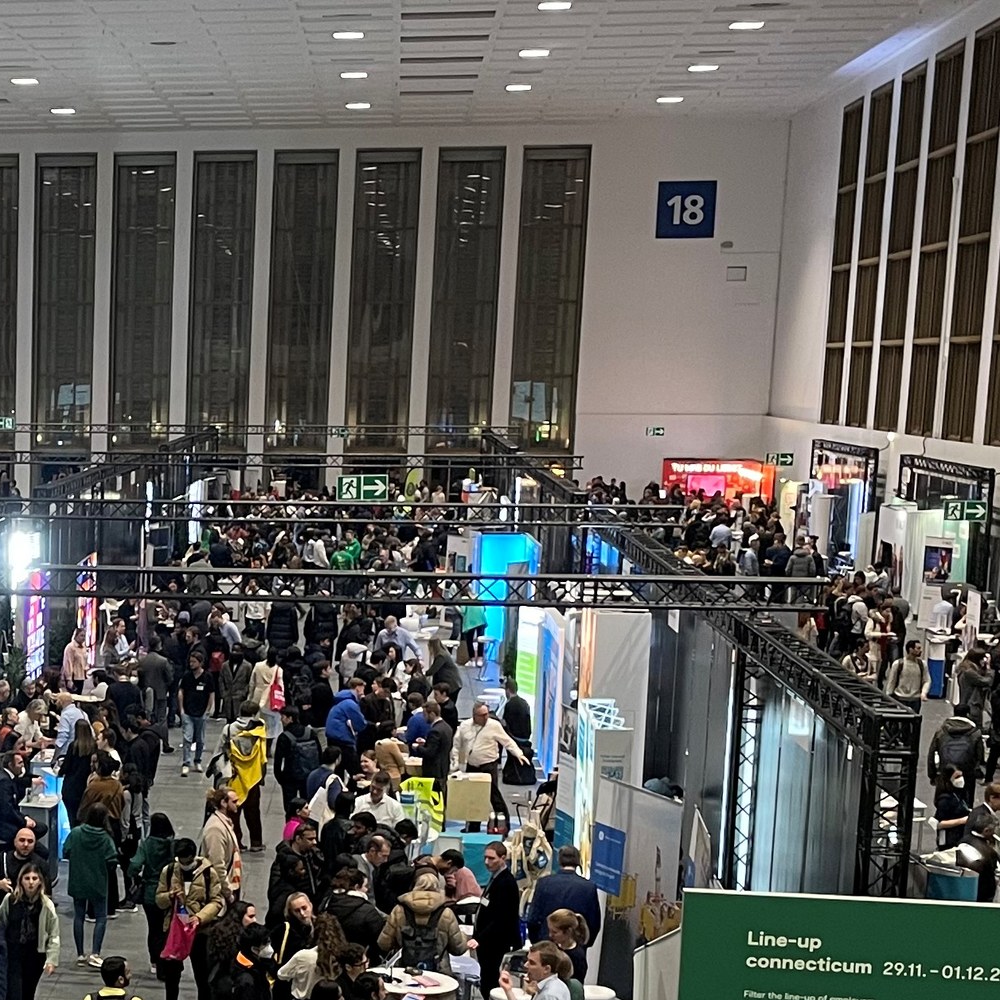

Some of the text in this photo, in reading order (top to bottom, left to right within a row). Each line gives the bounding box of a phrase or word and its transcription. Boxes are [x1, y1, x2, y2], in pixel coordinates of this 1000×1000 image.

[667, 194, 705, 225] 18
[747, 931, 822, 952] Line-up
[746, 956, 872, 975] connecticum
[883, 962, 927, 978] 29.11.
[744, 990, 766, 999] Filter
[768, 992, 783, 1000] the
